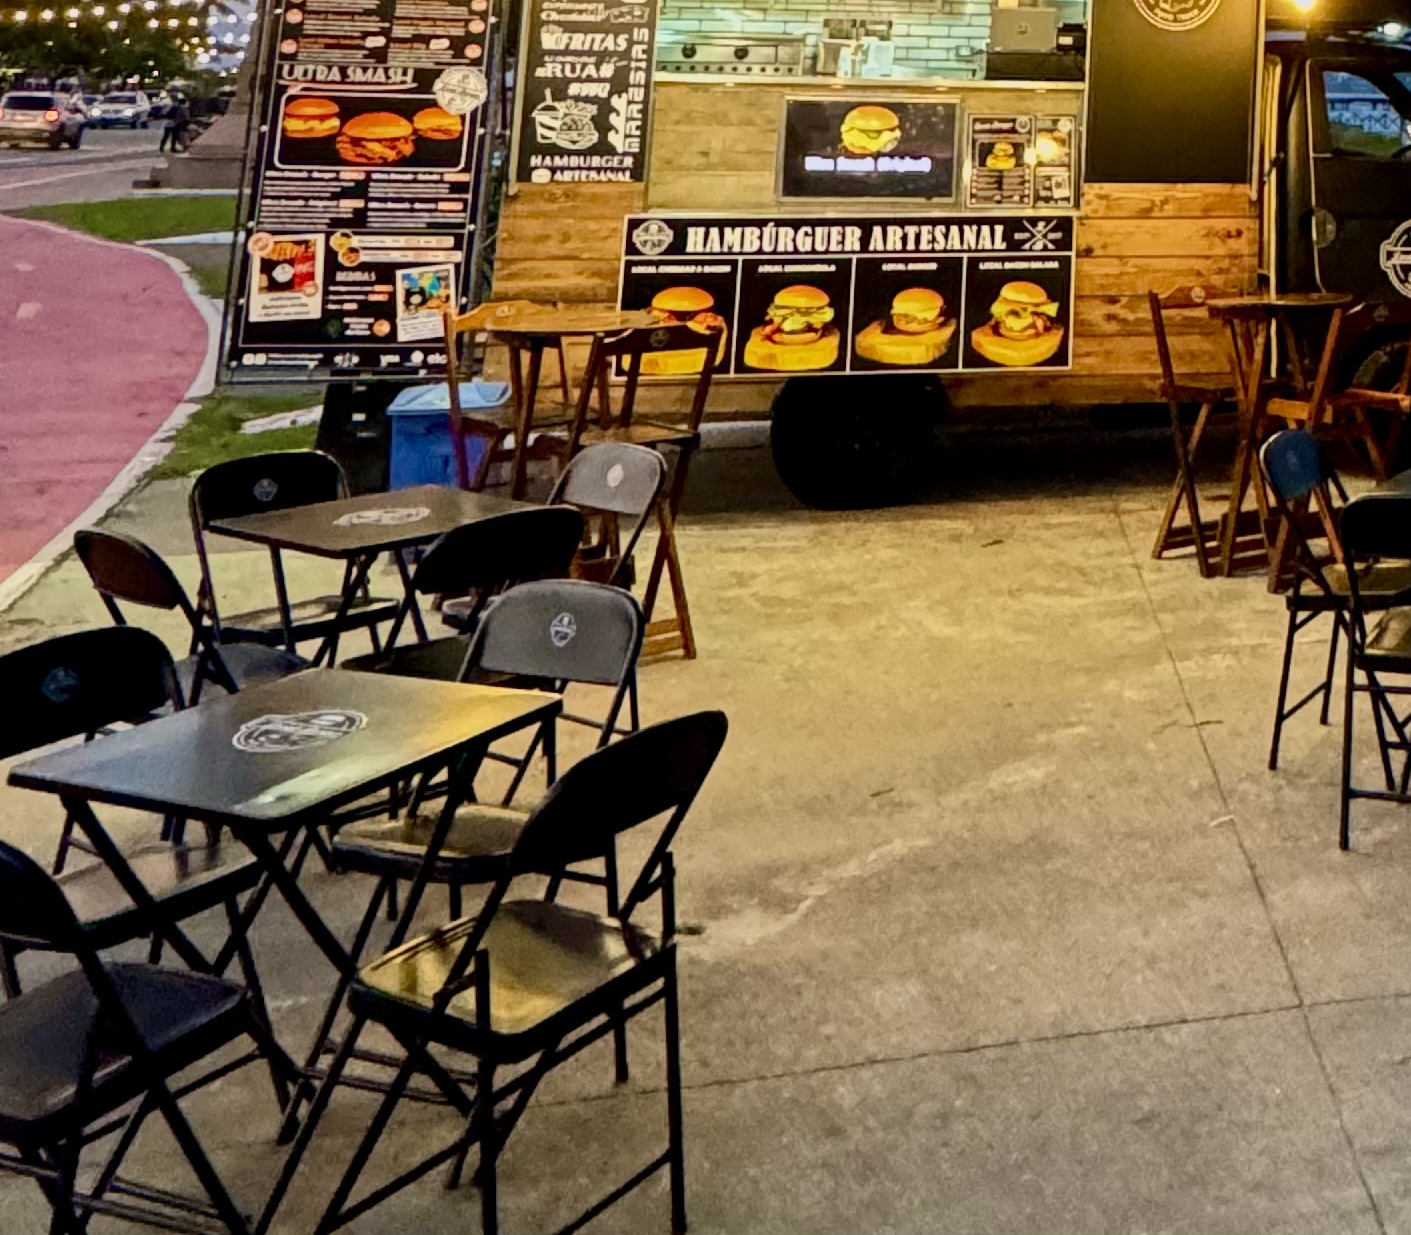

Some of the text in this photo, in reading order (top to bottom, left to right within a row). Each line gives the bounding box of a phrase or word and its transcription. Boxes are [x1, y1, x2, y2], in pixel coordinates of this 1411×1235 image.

[281, 64, 415, 84] ULTRA SMASH
[529, 154, 634, 168] HAMBURGER
[685, 222, 1007, 253] HAMBÚRGUER ARTESANAL
